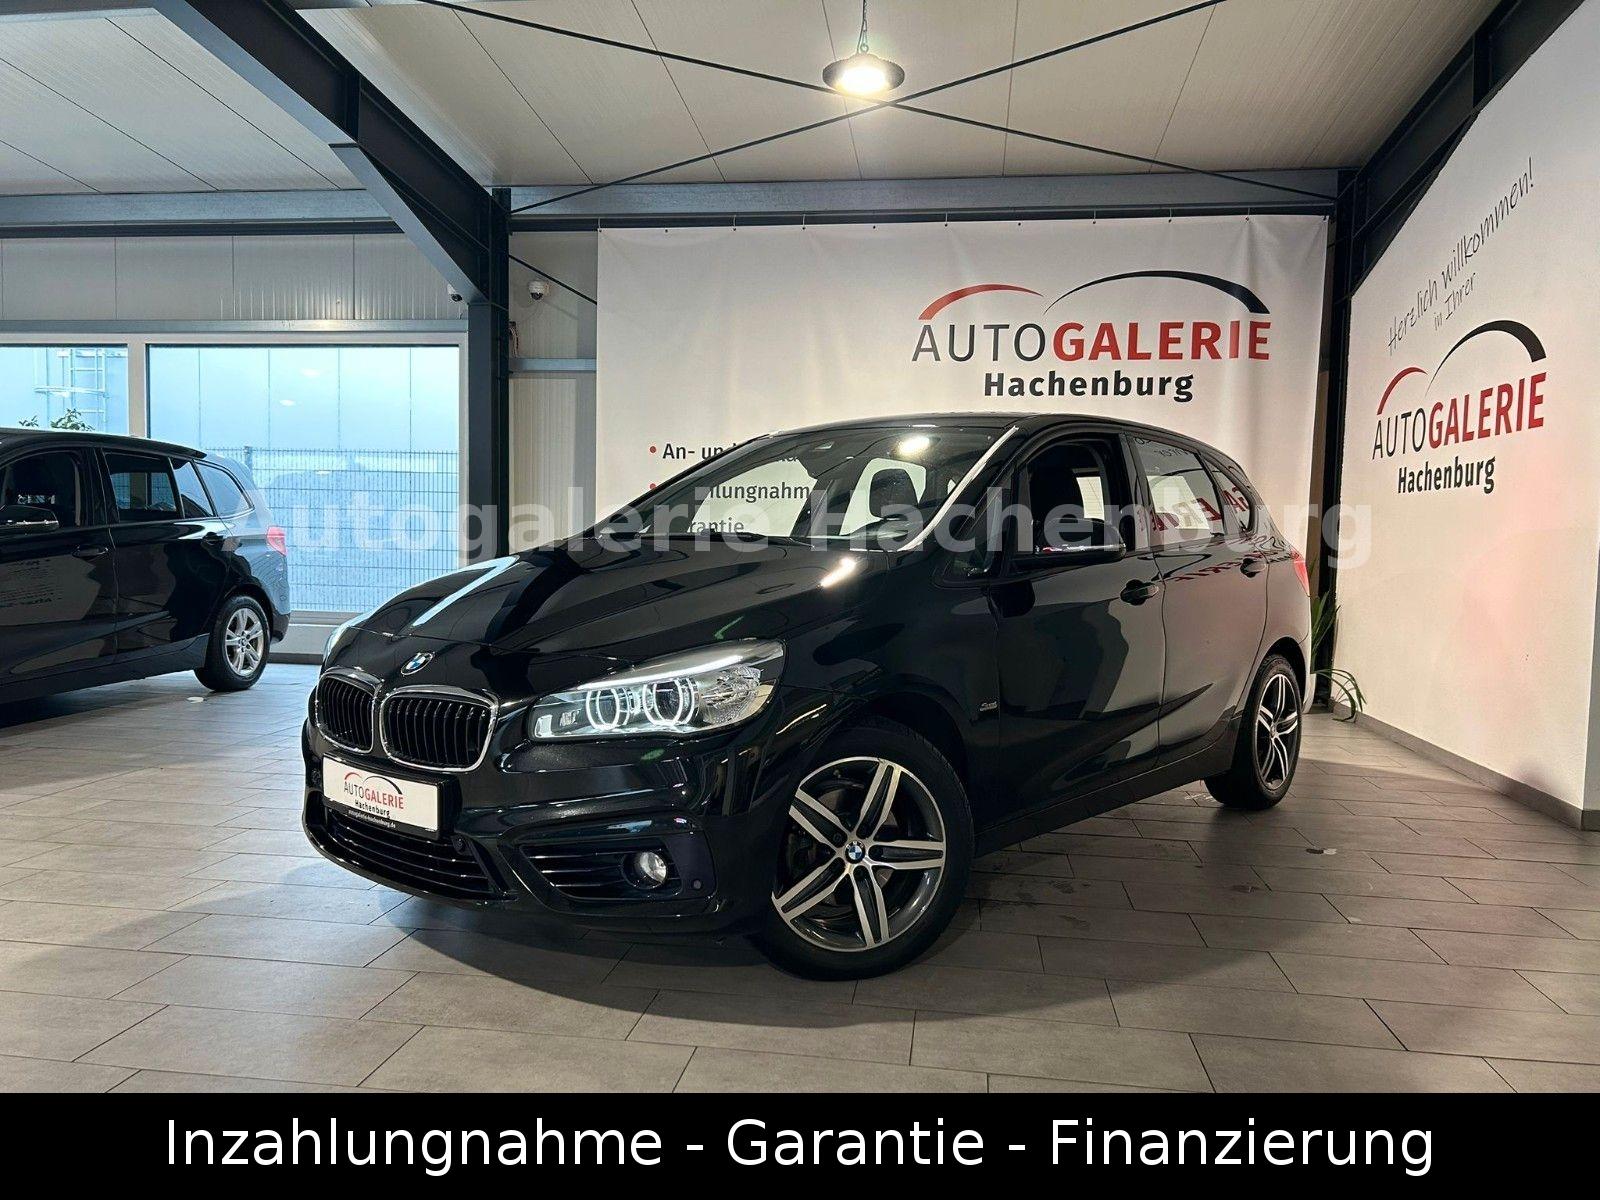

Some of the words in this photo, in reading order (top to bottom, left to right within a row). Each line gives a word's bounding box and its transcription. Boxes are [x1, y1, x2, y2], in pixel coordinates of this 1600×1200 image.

[1388, 278, 1439, 356] Herzlich
[1441, 156, 1535, 291] willkommen!
[911, 320, 1271, 361] AUTOGALERIE
[984, 370, 1194, 403] Hachenburg
[1372, 372, 1547, 460] AUTOGALERIE
[662, 443, 695, 460] An-
[1397, 456, 1497, 495] Hachenburg
[344, 780, 404, 810] AUTOGALERIE
